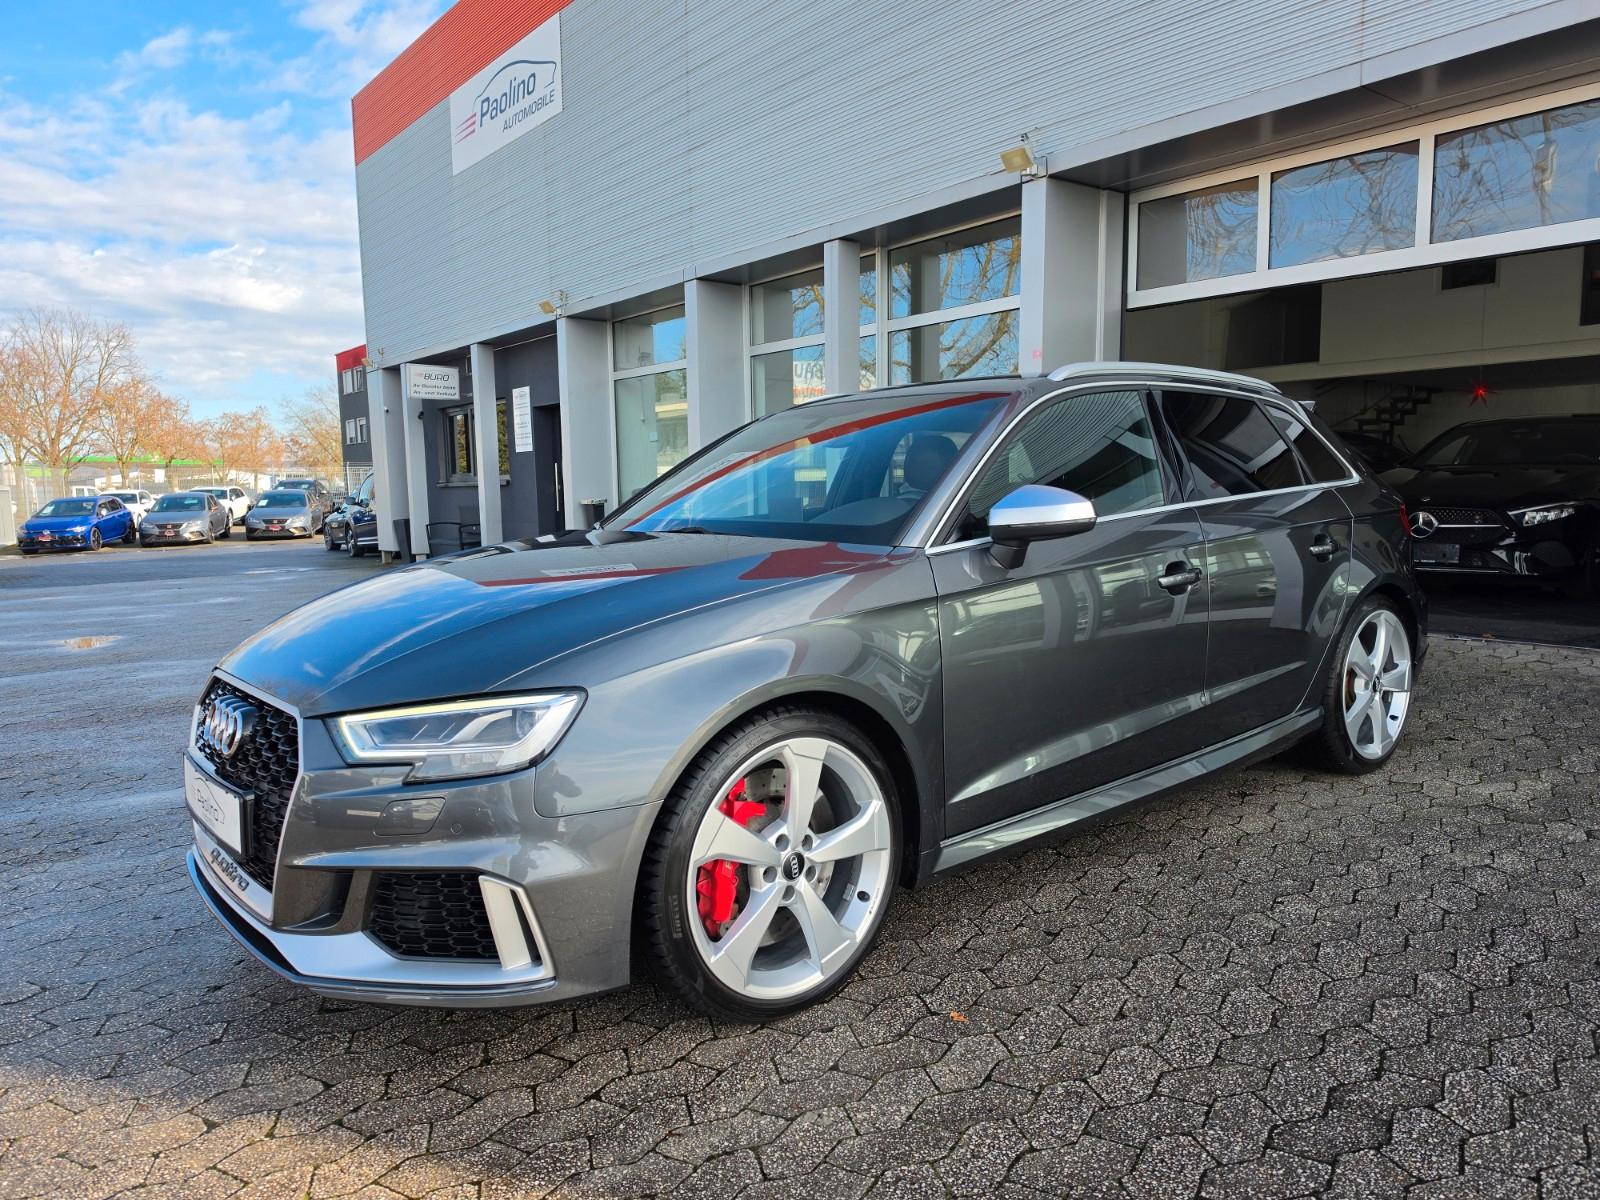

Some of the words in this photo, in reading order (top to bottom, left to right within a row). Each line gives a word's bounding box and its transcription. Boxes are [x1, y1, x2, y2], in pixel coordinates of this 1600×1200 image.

[479, 72, 536, 128] Paolino
[502, 89, 555, 133] AUTOMOBILE
[209, 847, 250, 892] quattro
